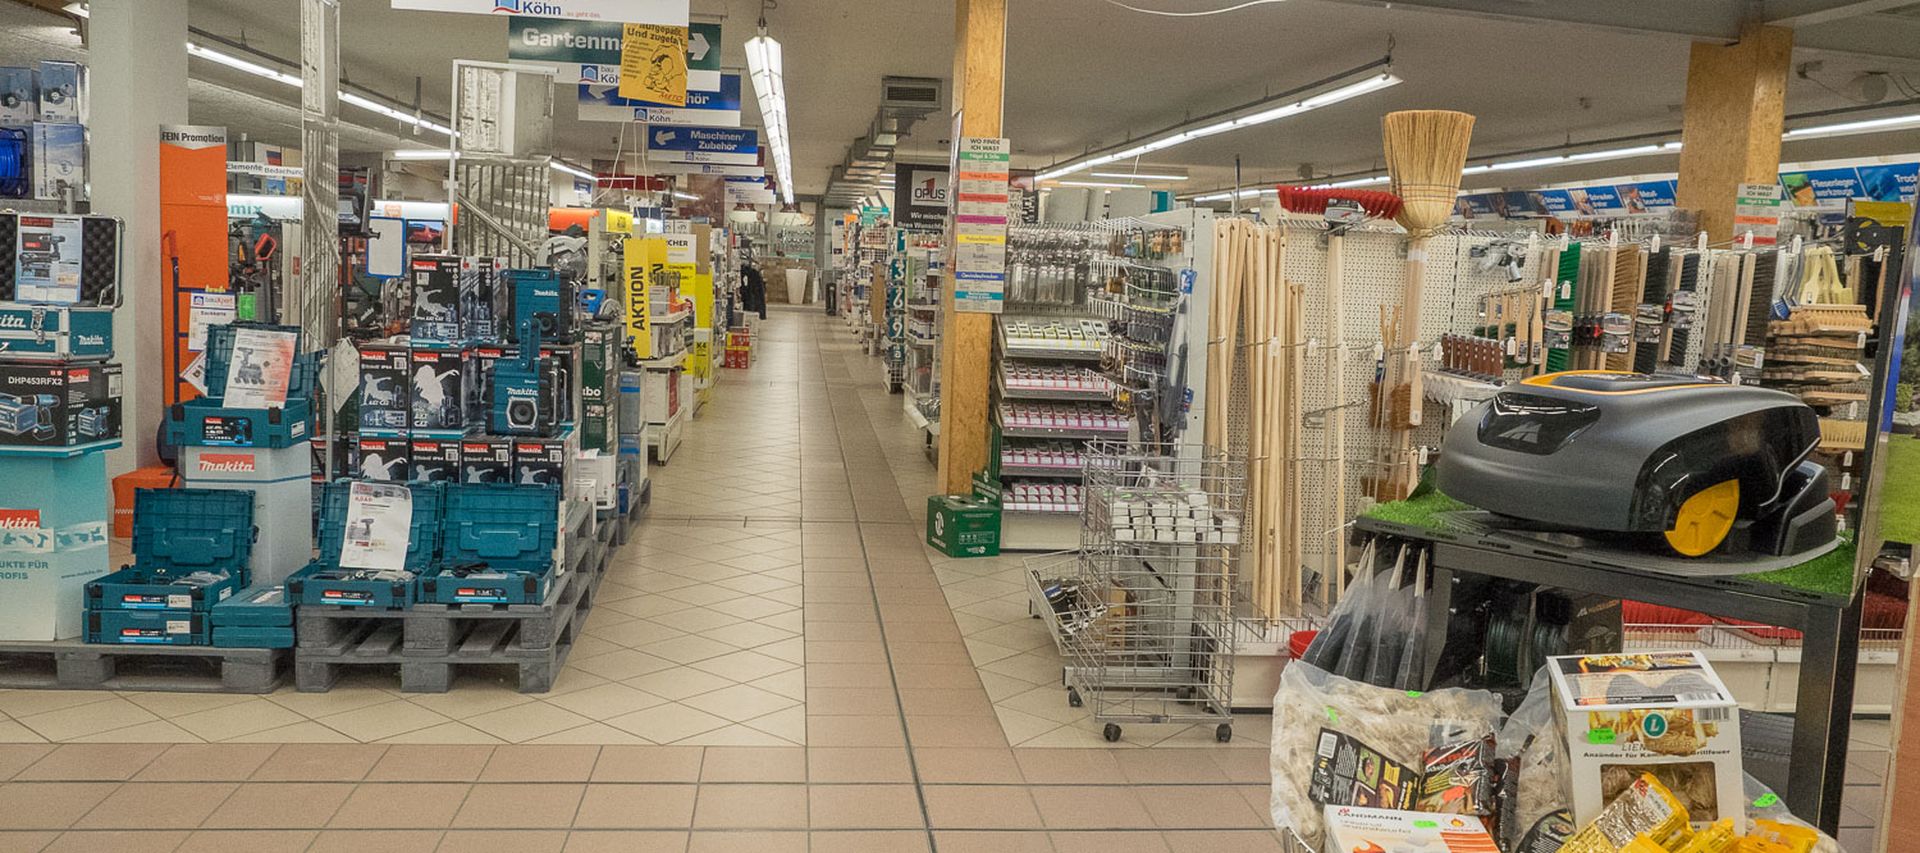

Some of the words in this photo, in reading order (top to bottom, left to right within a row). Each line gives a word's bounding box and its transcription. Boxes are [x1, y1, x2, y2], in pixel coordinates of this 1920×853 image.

[523, 1, 561, 15] Köhn
[522, 27, 623, 50] Gartenm
[627, 28, 648, 38] Und
[686, 93, 709, 104] hör
[161, 131, 179, 141] FEIN
[181, 132, 225, 143] Promotion
[690, 130, 745, 143] Maschinen/
[698, 141, 738, 151] Zubehör
[914, 187, 946, 200] OPUS
[228, 205, 263, 215] mix
[630, 266, 646, 331] AKTION
[0, 315, 26, 329] ita
[28, 559, 49, 569] FÜR
